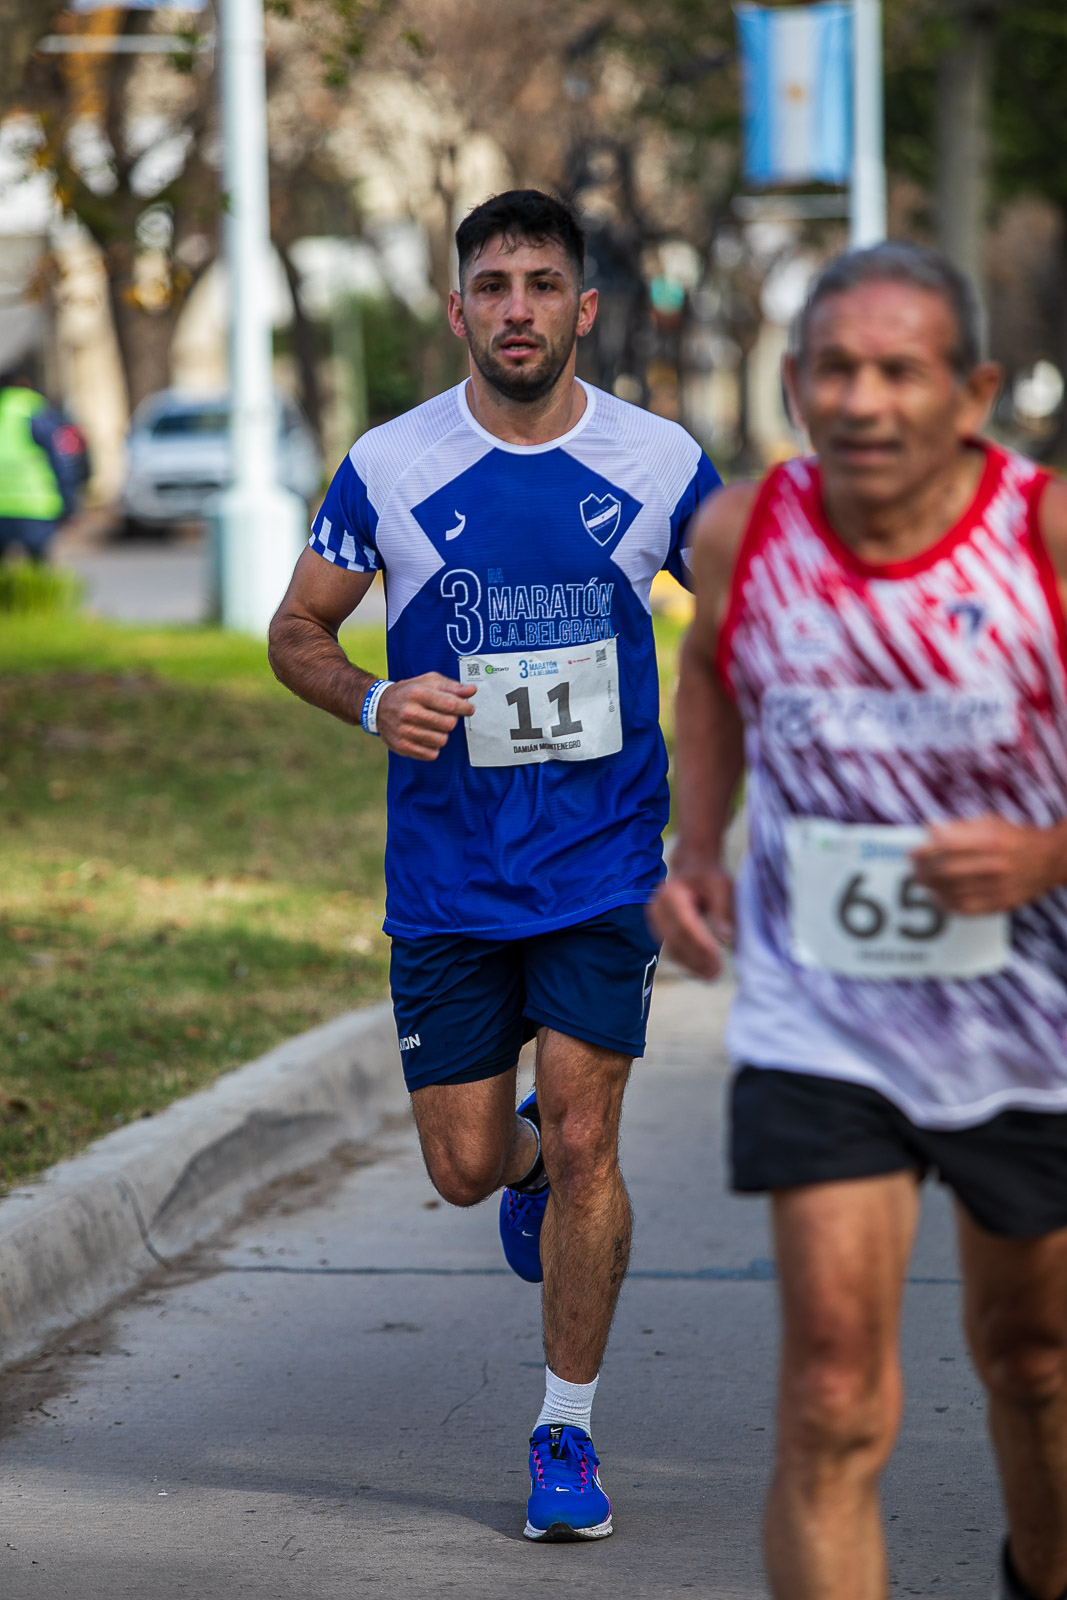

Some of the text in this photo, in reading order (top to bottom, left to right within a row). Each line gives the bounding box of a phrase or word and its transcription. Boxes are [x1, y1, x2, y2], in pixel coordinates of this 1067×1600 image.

[440, 568, 484, 656] 3
[487, 577, 615, 622] MARATÓN
[518, 659, 529, 679] 3
[505, 681, 583, 740] 11
[513, 739, 582, 754] DAMIÁN MONTENEGRO
[836, 872, 948, 941] 65
